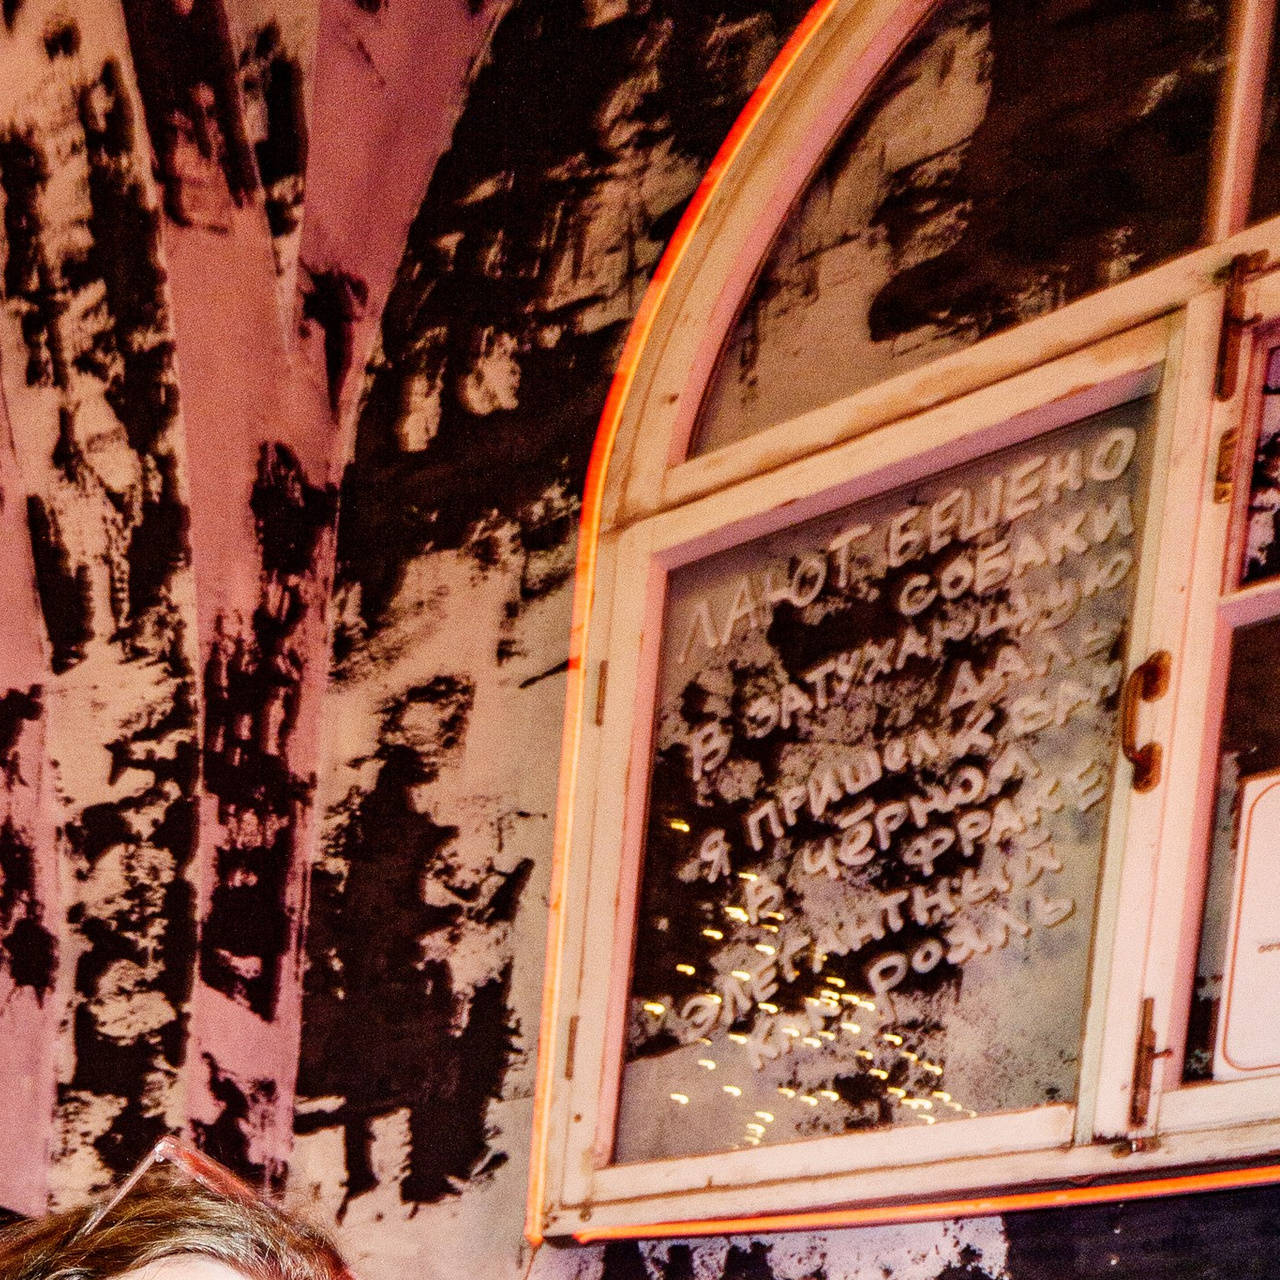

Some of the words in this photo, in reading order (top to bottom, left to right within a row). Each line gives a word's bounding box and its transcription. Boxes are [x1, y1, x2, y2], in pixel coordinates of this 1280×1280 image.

[678, 522, 871, 664] ЛАЮТ
[888, 428, 1137, 567] БЕШЕНО
[899, 494, 1134, 615] СОБАКИ
[691, 721, 731, 782] В
[745, 548, 1133, 739] ЗАТУХАЮЩУЮ
[700, 828, 732, 882] Я
[903, 763, 1105, 876] ФРАКЕ
[679, 829, 1063, 1044] ЭЛЕГАНТНЫЙ
[745, 878, 783, 926] В
